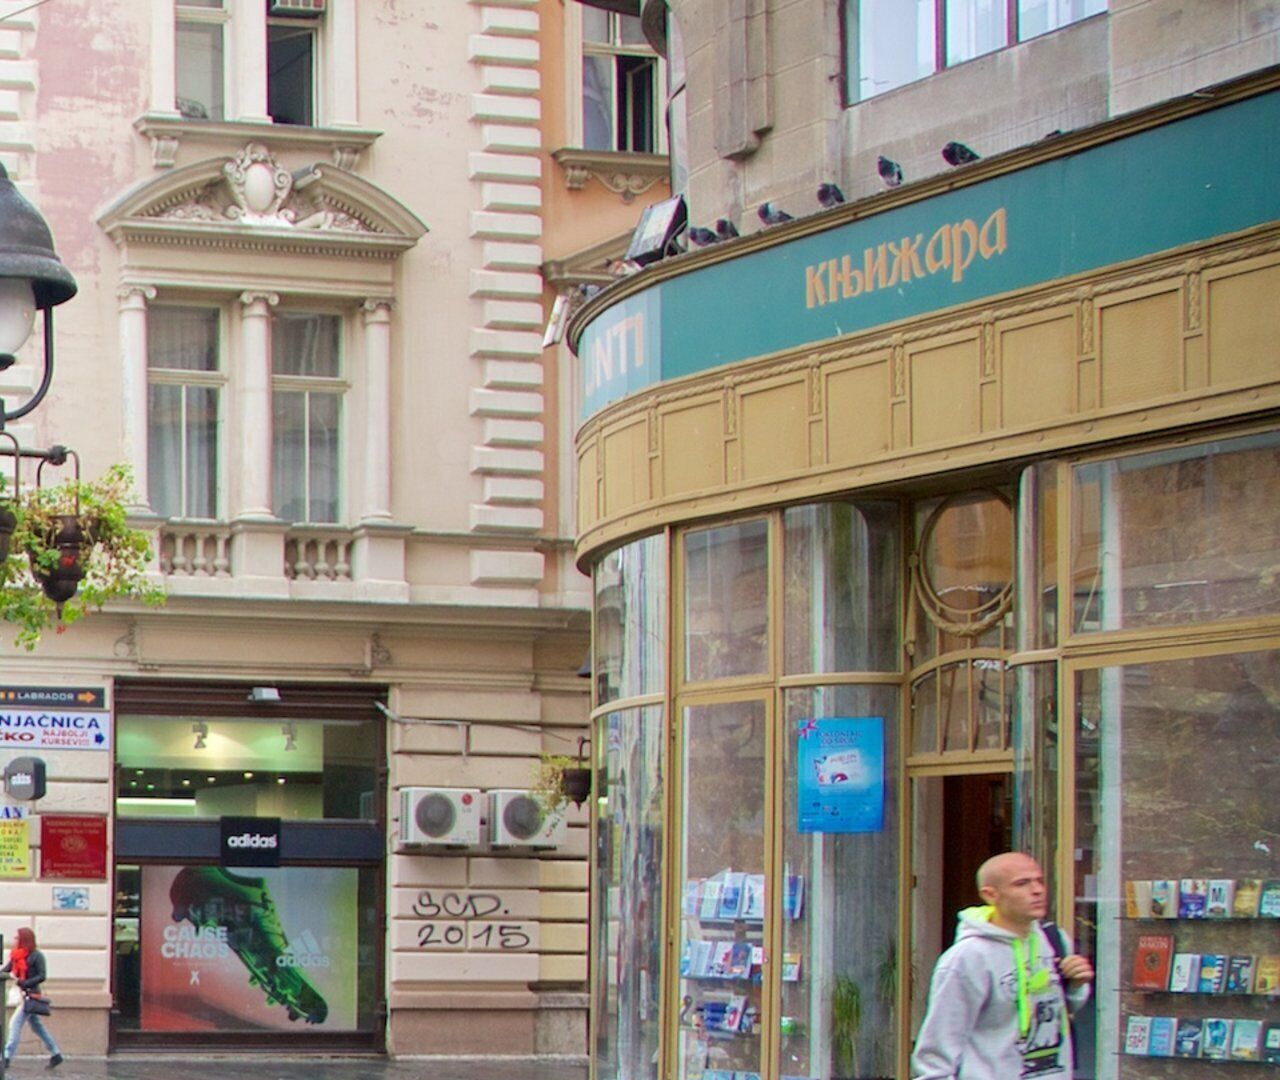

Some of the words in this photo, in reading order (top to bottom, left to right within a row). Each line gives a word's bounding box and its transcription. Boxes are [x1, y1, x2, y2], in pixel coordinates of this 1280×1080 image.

[17, 690, 74, 700] LABRADOR
[227, 832, 277, 848] adidas
[163, 925, 228, 942] CAUSE
[417, 924, 530, 949] 2015
[161, 942, 229, 958] CHAOS
[276, 952, 330, 967] adidas
